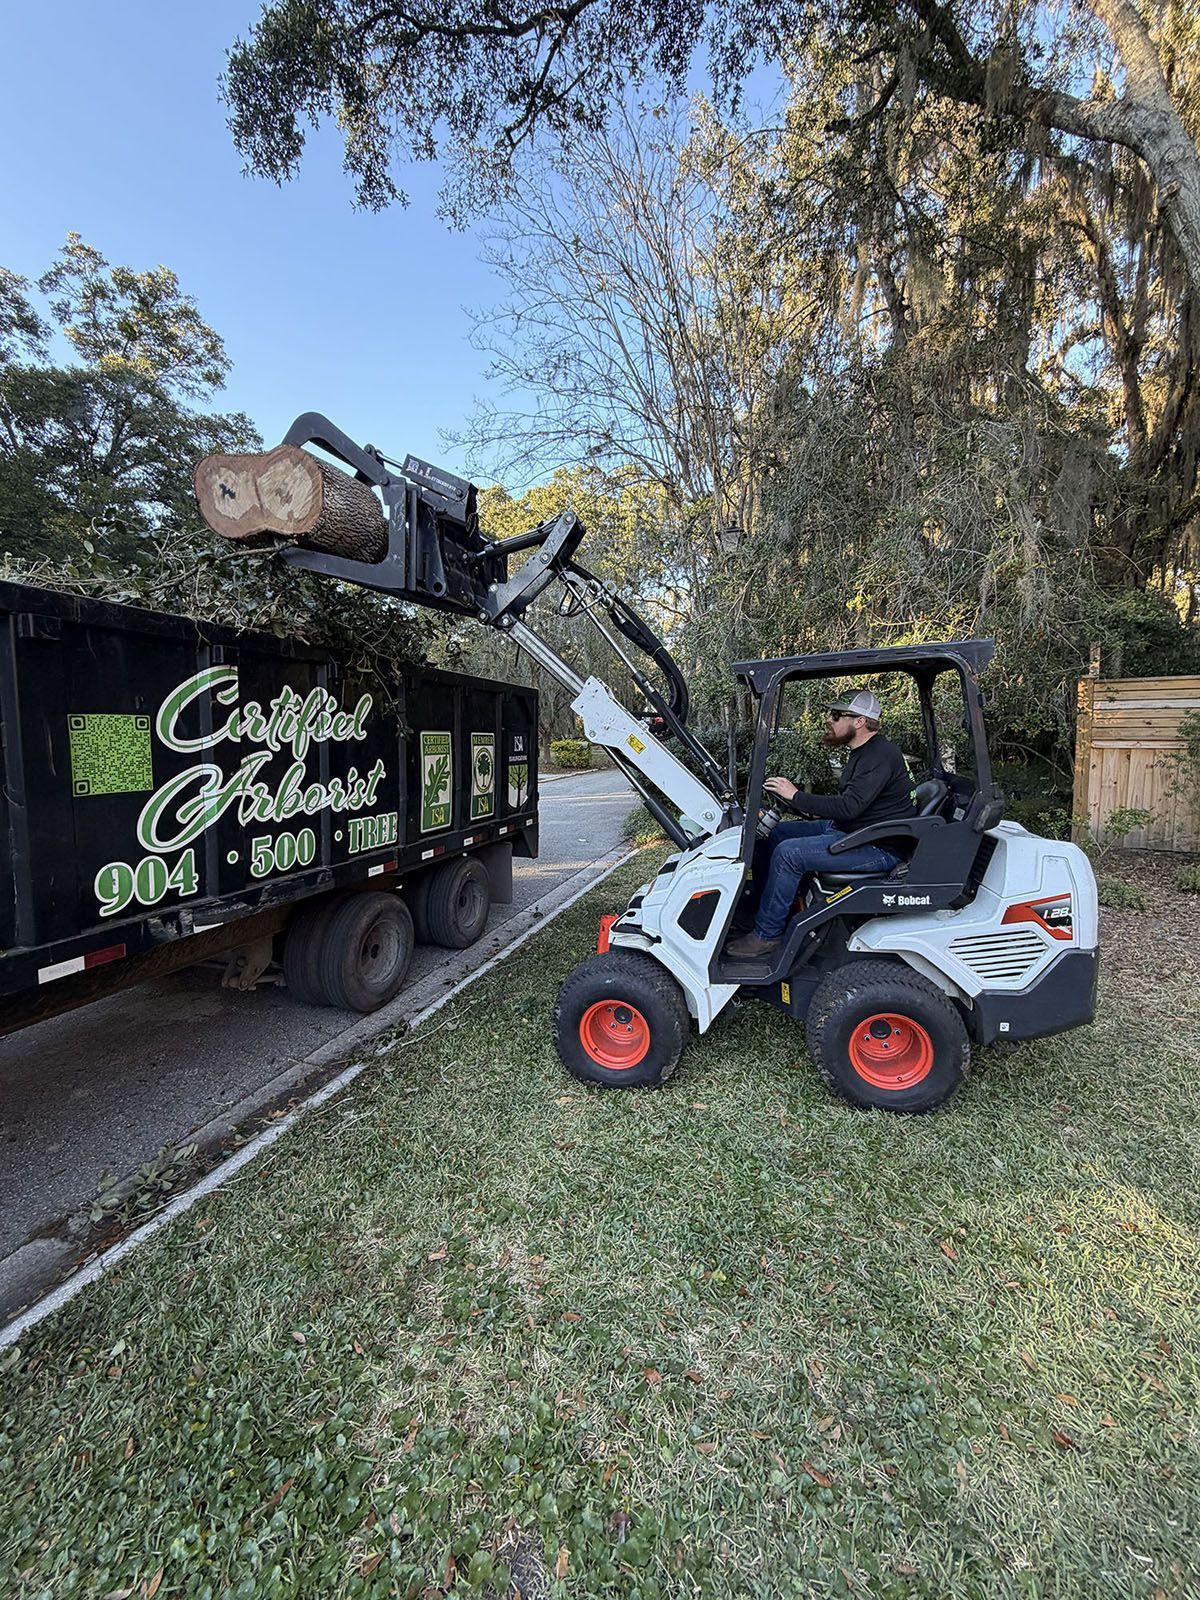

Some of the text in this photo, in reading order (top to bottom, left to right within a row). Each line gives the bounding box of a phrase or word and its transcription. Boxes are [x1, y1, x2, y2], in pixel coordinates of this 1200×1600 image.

[156, 665, 373, 760] Certified
[137, 751, 386, 853] Arborist
[431, 807, 445, 825] ISA
[94, 812, 398, 917] 904 500 TREE
[898, 895, 931, 906] Bobcat
